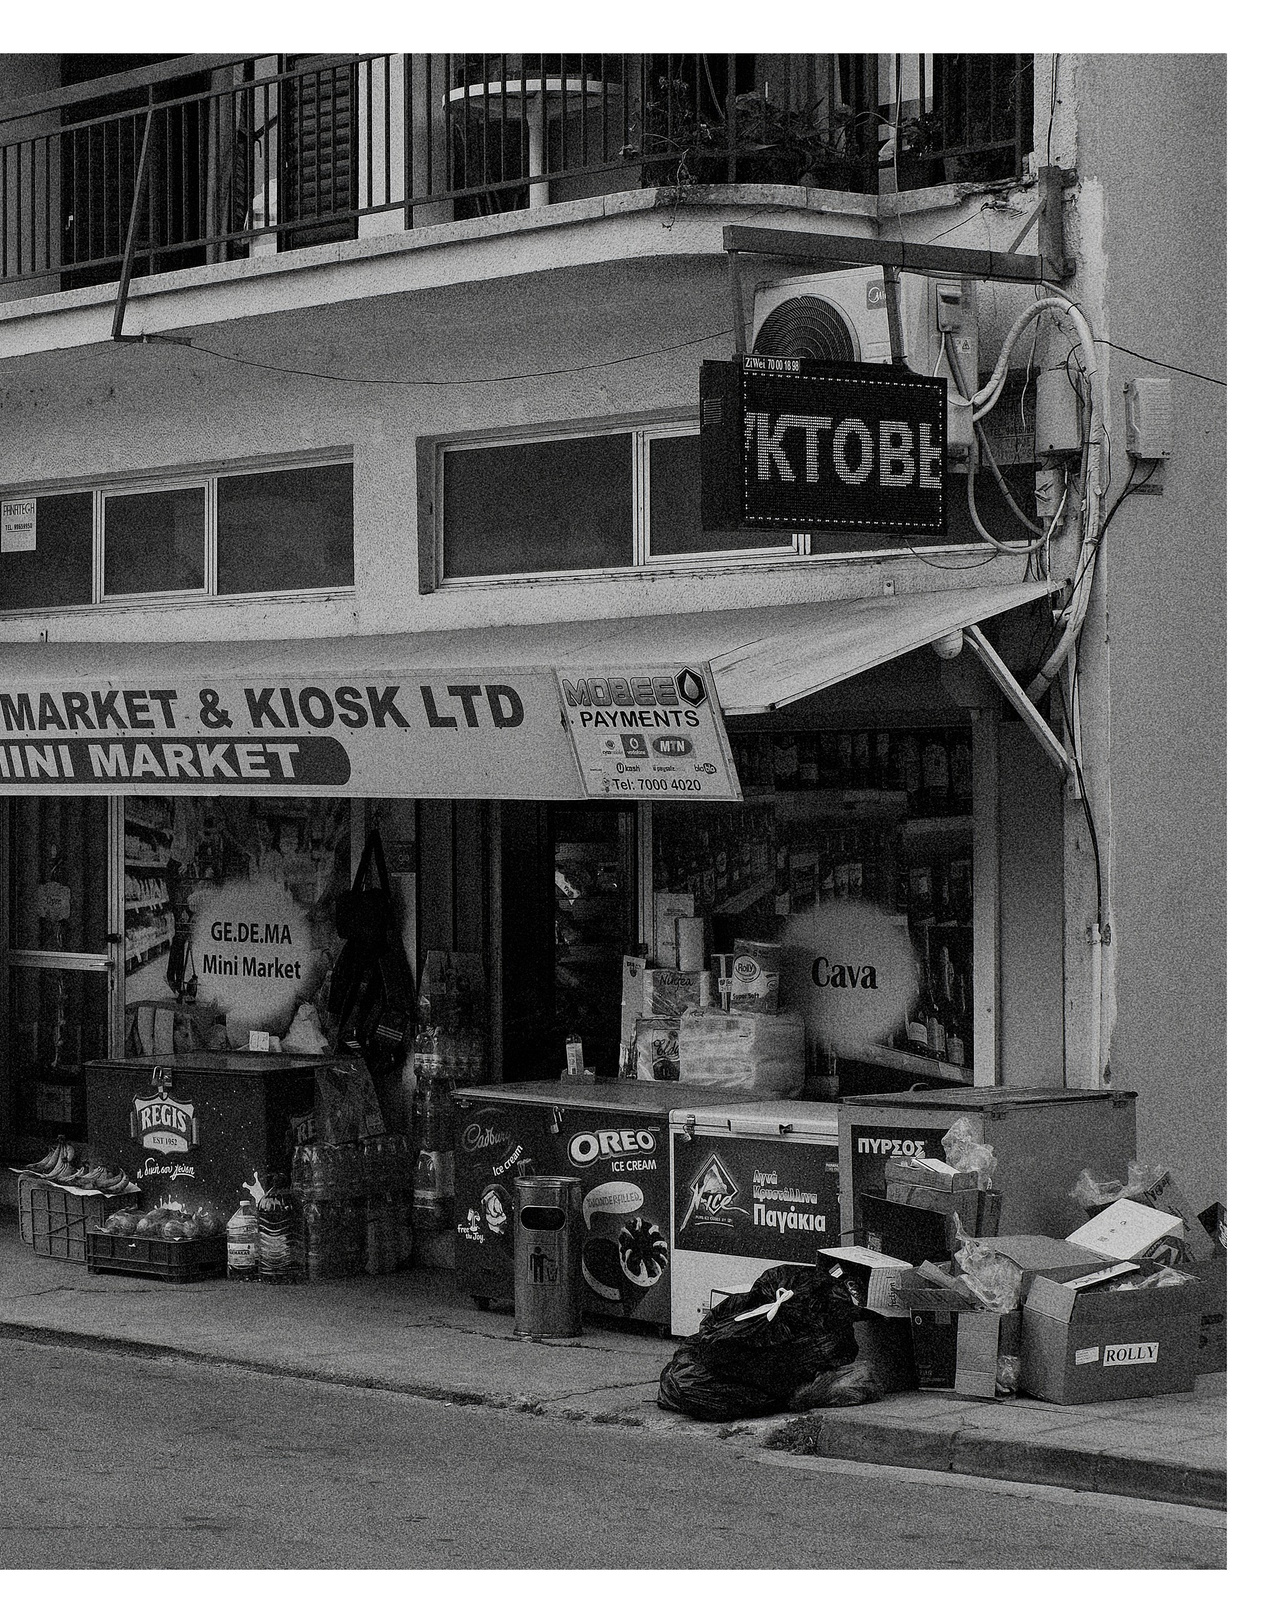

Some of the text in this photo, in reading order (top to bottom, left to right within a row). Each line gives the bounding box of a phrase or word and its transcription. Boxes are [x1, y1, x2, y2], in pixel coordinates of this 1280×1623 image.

[562, 676, 680, 707] MOBEE
[198, 688, 234, 729] &
[244, 685, 411, 729] KIOSK
[420, 684, 525, 728] LTD
[579, 710, 700, 728] PAYMENTS
[660, 740, 685, 752] MTN
[88, 743, 300, 778] MARKET
[612, 778, 702, 792] Tel: 7000 4020
[210, 921, 292, 945] GE.DE.MA
[203, 953, 302, 979] Mini Market
[811, 956, 879, 990] Cava
[140, 1104, 187, 1133] REGIS
[152, 1136, 178, 1146] EST 1952
[570, 1129, 656, 1164] OREO
[857, 1137, 926, 1157] ΠΥΡΣΟΣ
[492, 1145, 524, 1177] Ice cream
[611, 1159, 658, 1173] ICE CREAM
[752, 1169, 779, 1187] Αγνά
[752, 1185, 819, 1205] Κρυστάλλινα
[753, 1203, 827, 1234] Παγάκια
[1106, 1345, 1157, 1363] ROLLY
